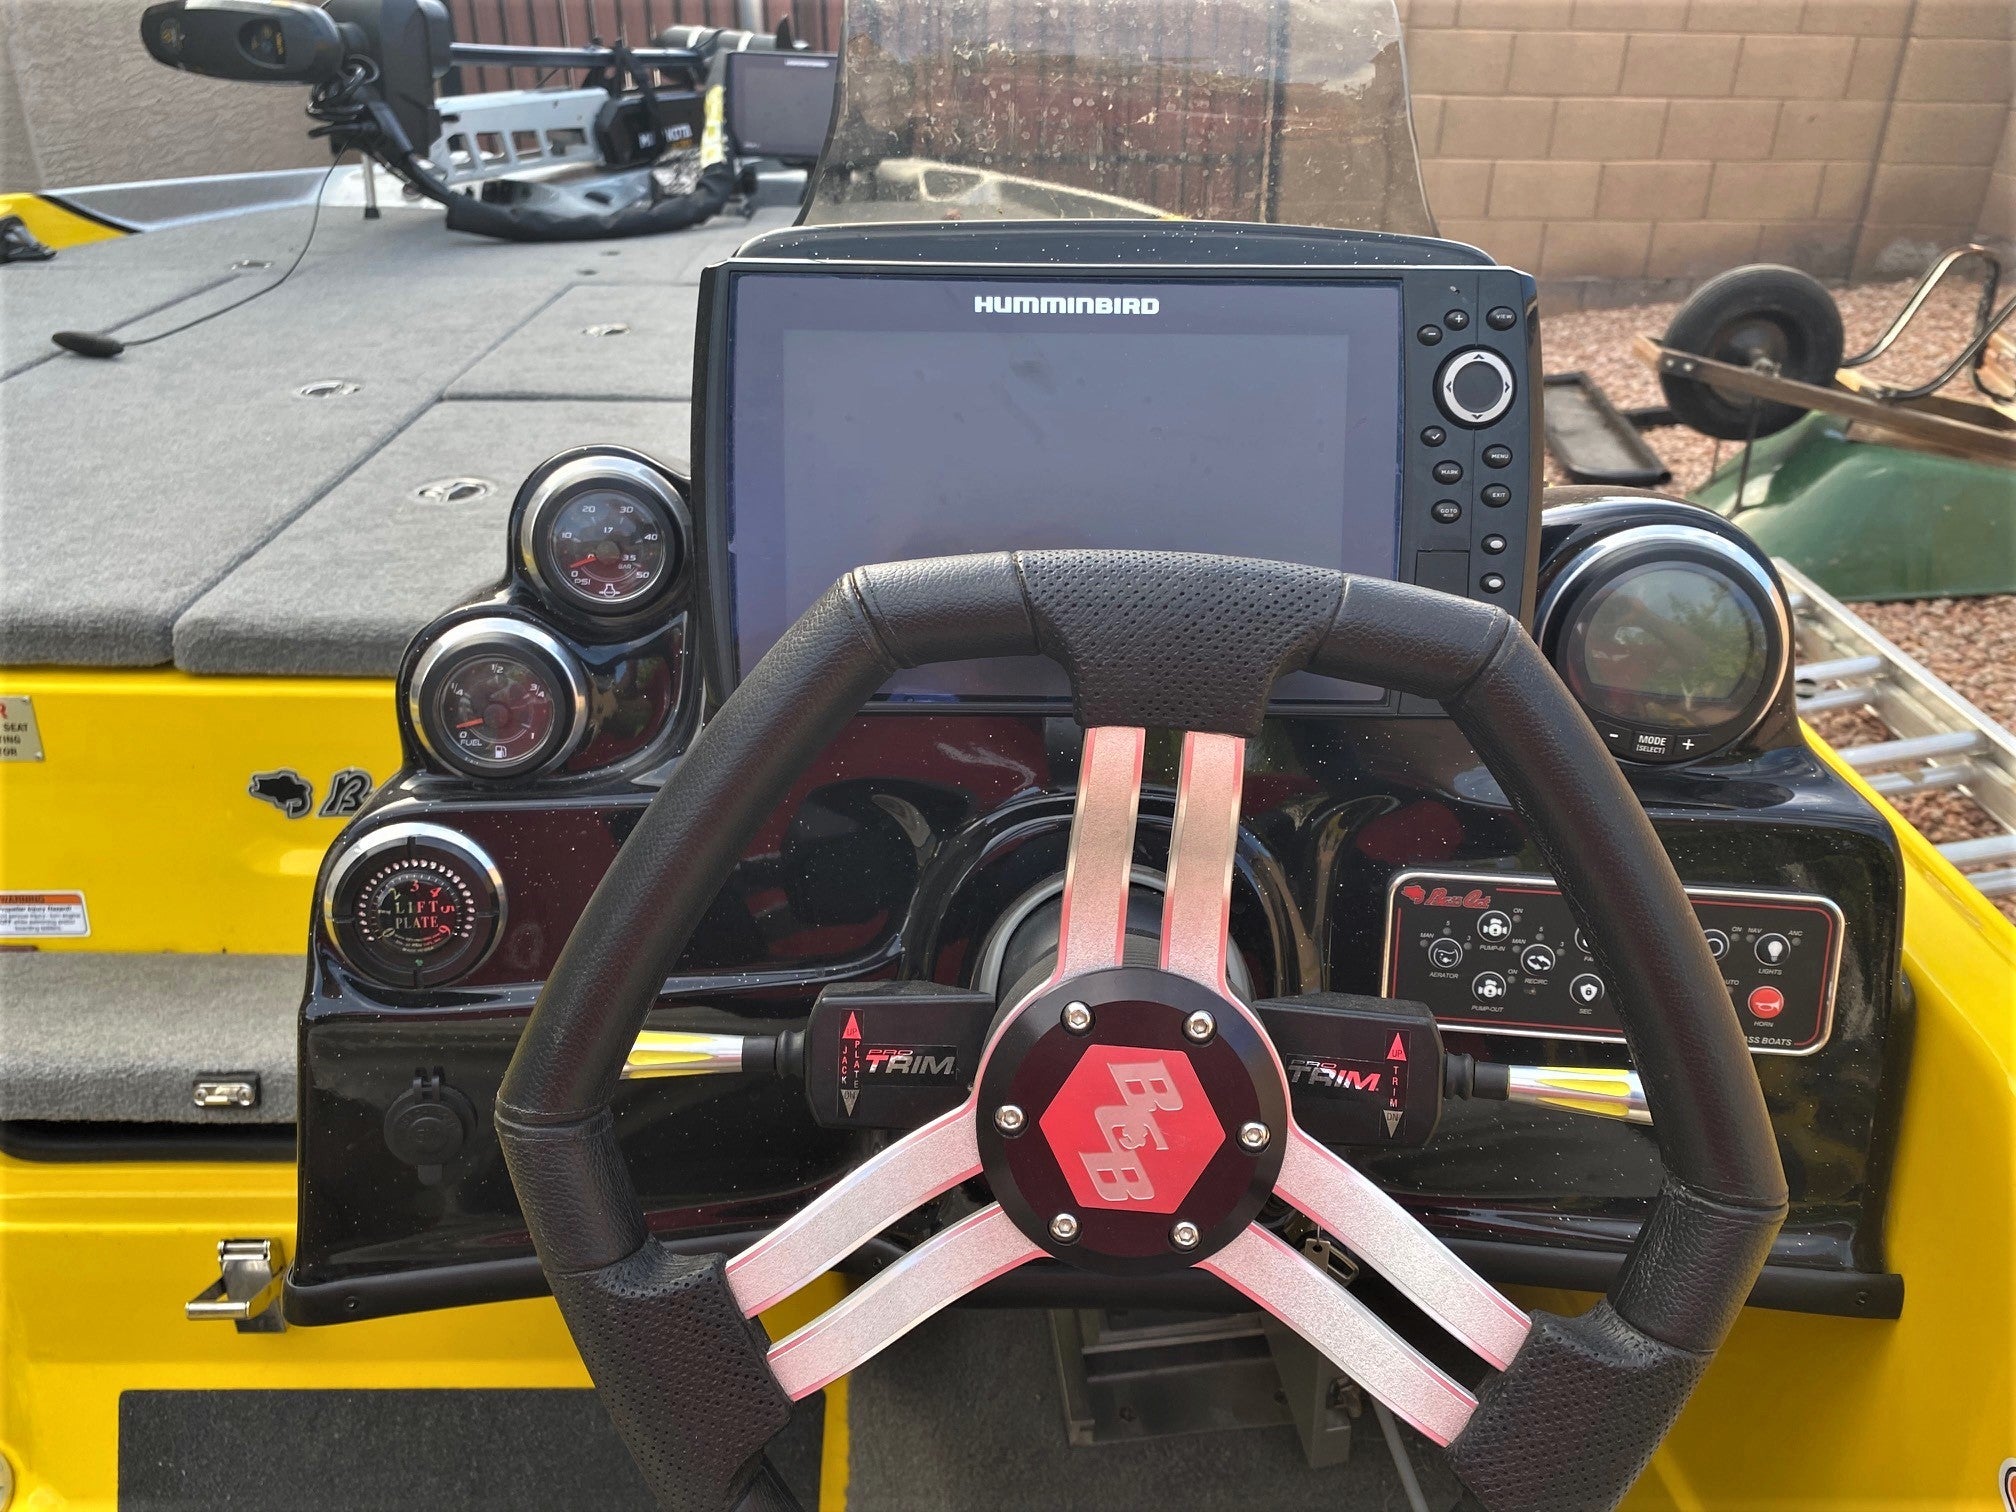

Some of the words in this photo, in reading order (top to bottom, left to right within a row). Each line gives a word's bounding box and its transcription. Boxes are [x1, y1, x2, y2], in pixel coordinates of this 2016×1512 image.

[974, 296, 1160, 315] HUMMINBIRD
[582, 505, 596, 513] 20
[620, 506, 634, 514] 30
[571, 570, 579, 578] 0
[635, 571, 650, 579] 50
[491, 663, 504, 674] 1/2
[451, 682, 464, 696] 1/4
[530, 683, 545, 698] 3/4
[3, 723, 28, 732] SEAT
[460, 731, 468, 739] 0
[460, 739, 482, 747] FUEL
[1638, 734, 1667, 747] MODE
[410, 879, 419, 892] 3
[388, 887, 401, 900] 2
[430, 886, 441, 898] 4
[394, 900, 439, 914] LIFT
[440, 904, 455, 914] 5
[395, 916, 439, 929] PLATE
[1479, 944, 1506, 952] PUMP-IN
[1429, 971, 1459, 979] AERATOR
[1758, 968, 1783, 976] LIGHTS
[1524, 977, 1548, 985] RECIRC
[1471, 1004, 1504, 1013] PUMP-OUT
[847, 1028, 857, 1036] UP
[1761, 1036, 1792, 1046] BOATS
[1391, 1049, 1403, 1058] UP
[1290, 1059, 1337, 1069] PRO
[1389, 1065, 1400, 1108] TRIM
[1386, 1112, 1399, 1121] DN
